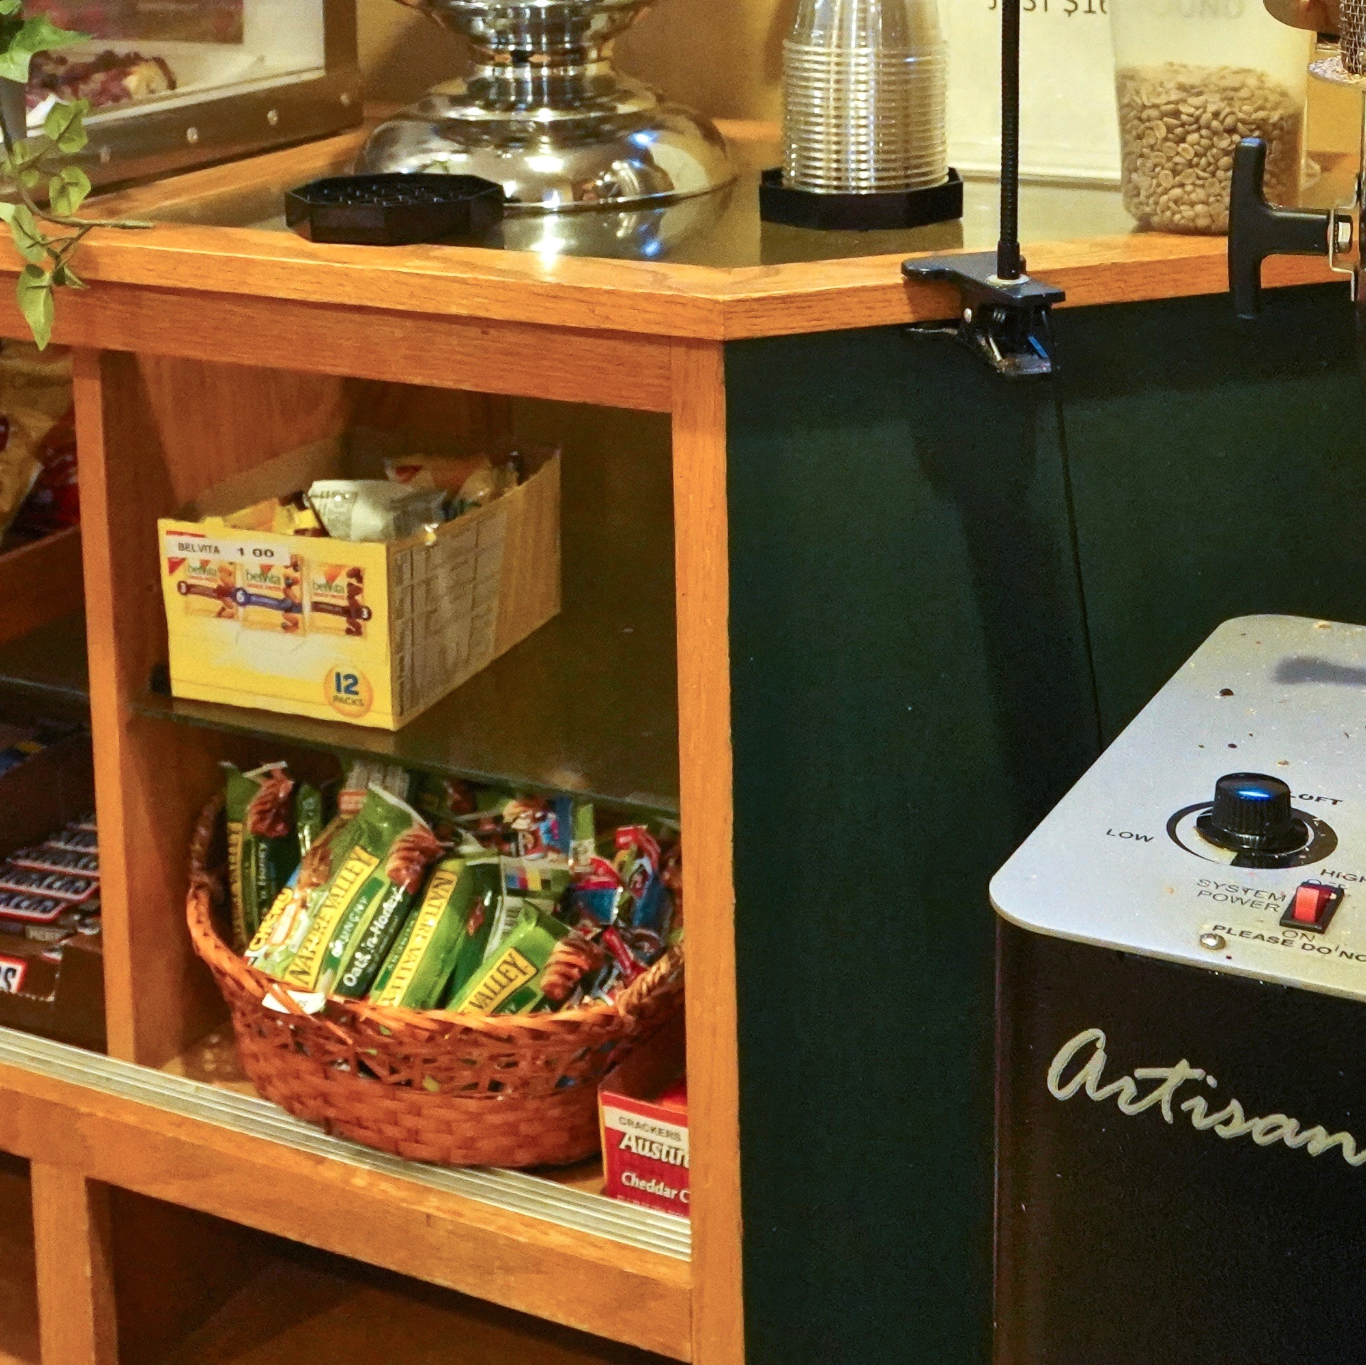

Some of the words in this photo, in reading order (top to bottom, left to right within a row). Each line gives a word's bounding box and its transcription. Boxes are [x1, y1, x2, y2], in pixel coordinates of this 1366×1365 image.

[178, 542, 220, 554] BELVITA
[335, 671, 360, 696] 12
[1106, 827, 1154, 843] LOW
[1196, 877, 1287, 902] SYSTEM
[1197, 889, 1281, 913] POWER
[289, 909, 334, 986] NATURE
[325, 851, 373, 913] VALLEY
[1211, 924, 1294, 947] PLEASE
[1300, 942, 1332, 956] DO
[1281, 930, 1316, 942] ON
[469, 951, 528, 1012] VALLEY
[618, 1115, 682, 1142] CRACKERS
[619, 1132, 689, 1169] Austin
[621, 1171, 678, 1200] Cheddar
